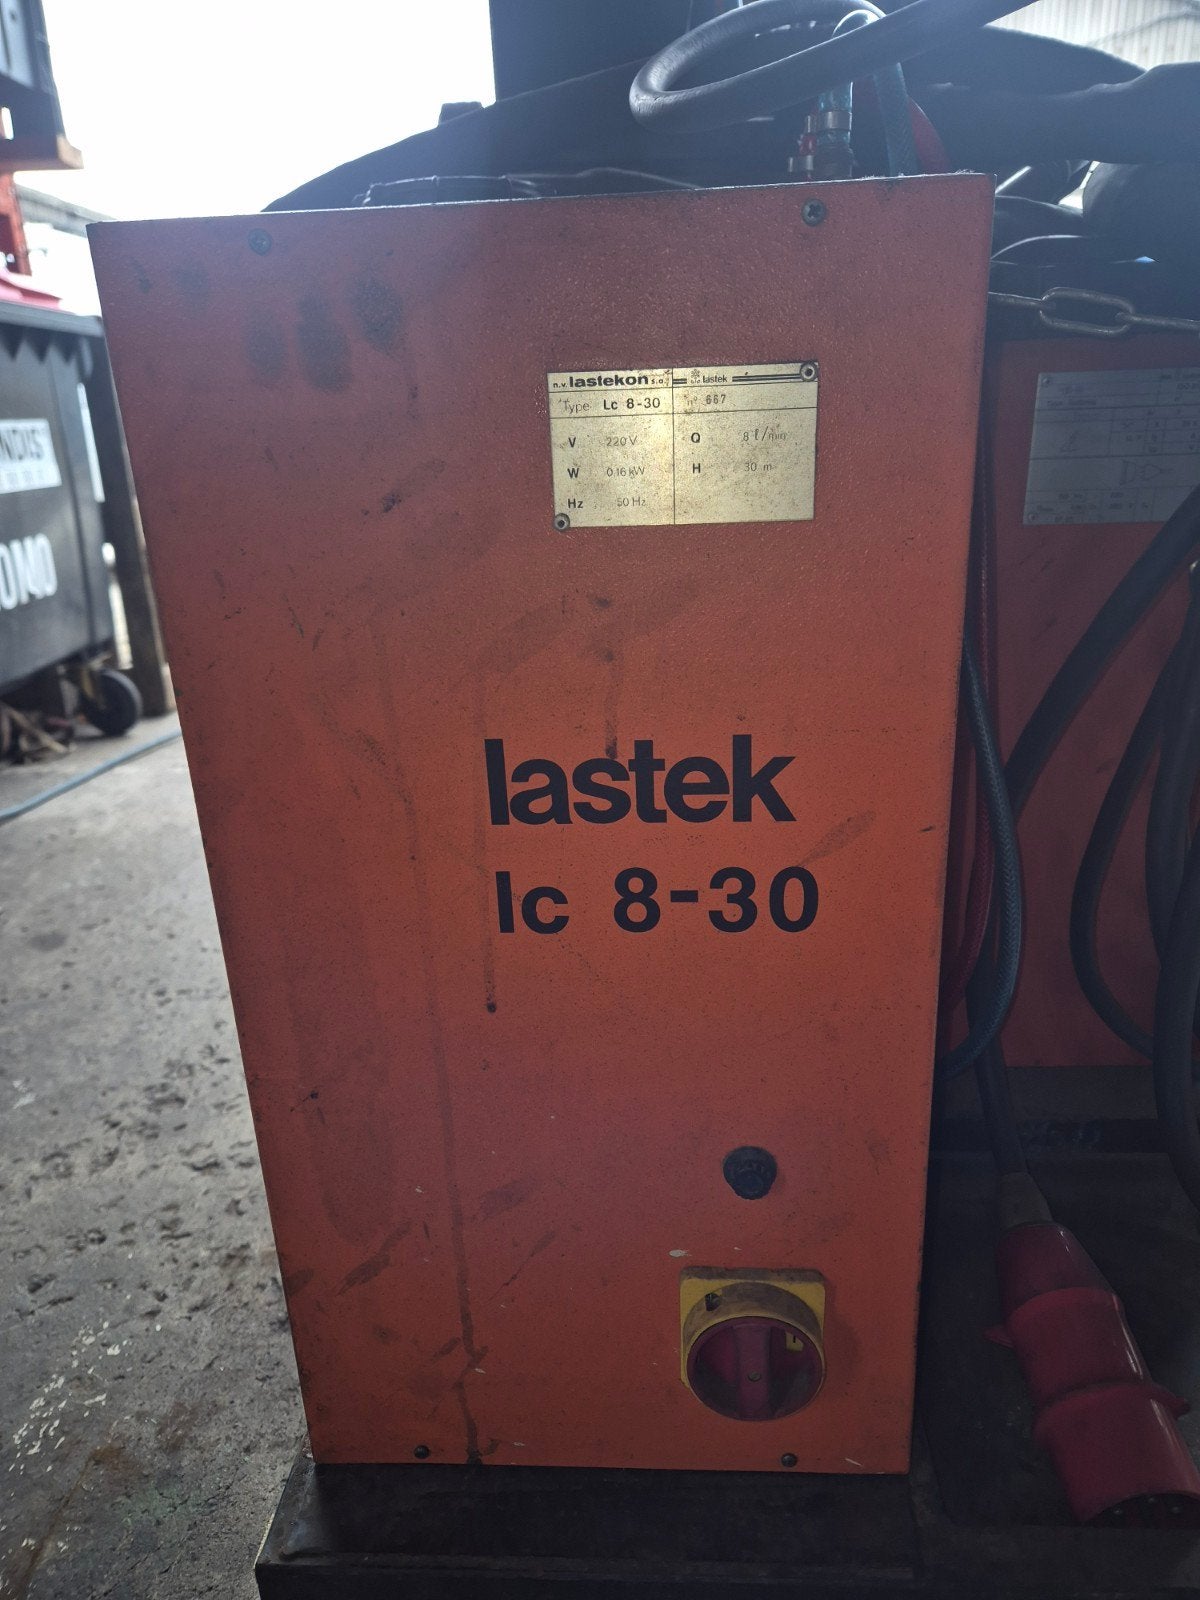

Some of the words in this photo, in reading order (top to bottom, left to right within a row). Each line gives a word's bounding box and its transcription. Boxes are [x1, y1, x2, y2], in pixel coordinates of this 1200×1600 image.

[569, 375, 648, 387] lastekon
[706, 394, 726, 404] 667
[563, 399, 590, 414] Type
[603, 399, 618, 410] Lc
[626, 397, 660, 409] 8-30
[568, 437, 576, 447] V
[690, 432, 701, 443] Q
[742, 431, 750, 441] 8
[567, 467, 579, 478] W
[692, 463, 701, 473] H
[744, 462, 757, 471] 30
[567, 498, 583, 508] Hz
[484, 734, 797, 825] lastek
[613, 866, 819, 933] 8-30
